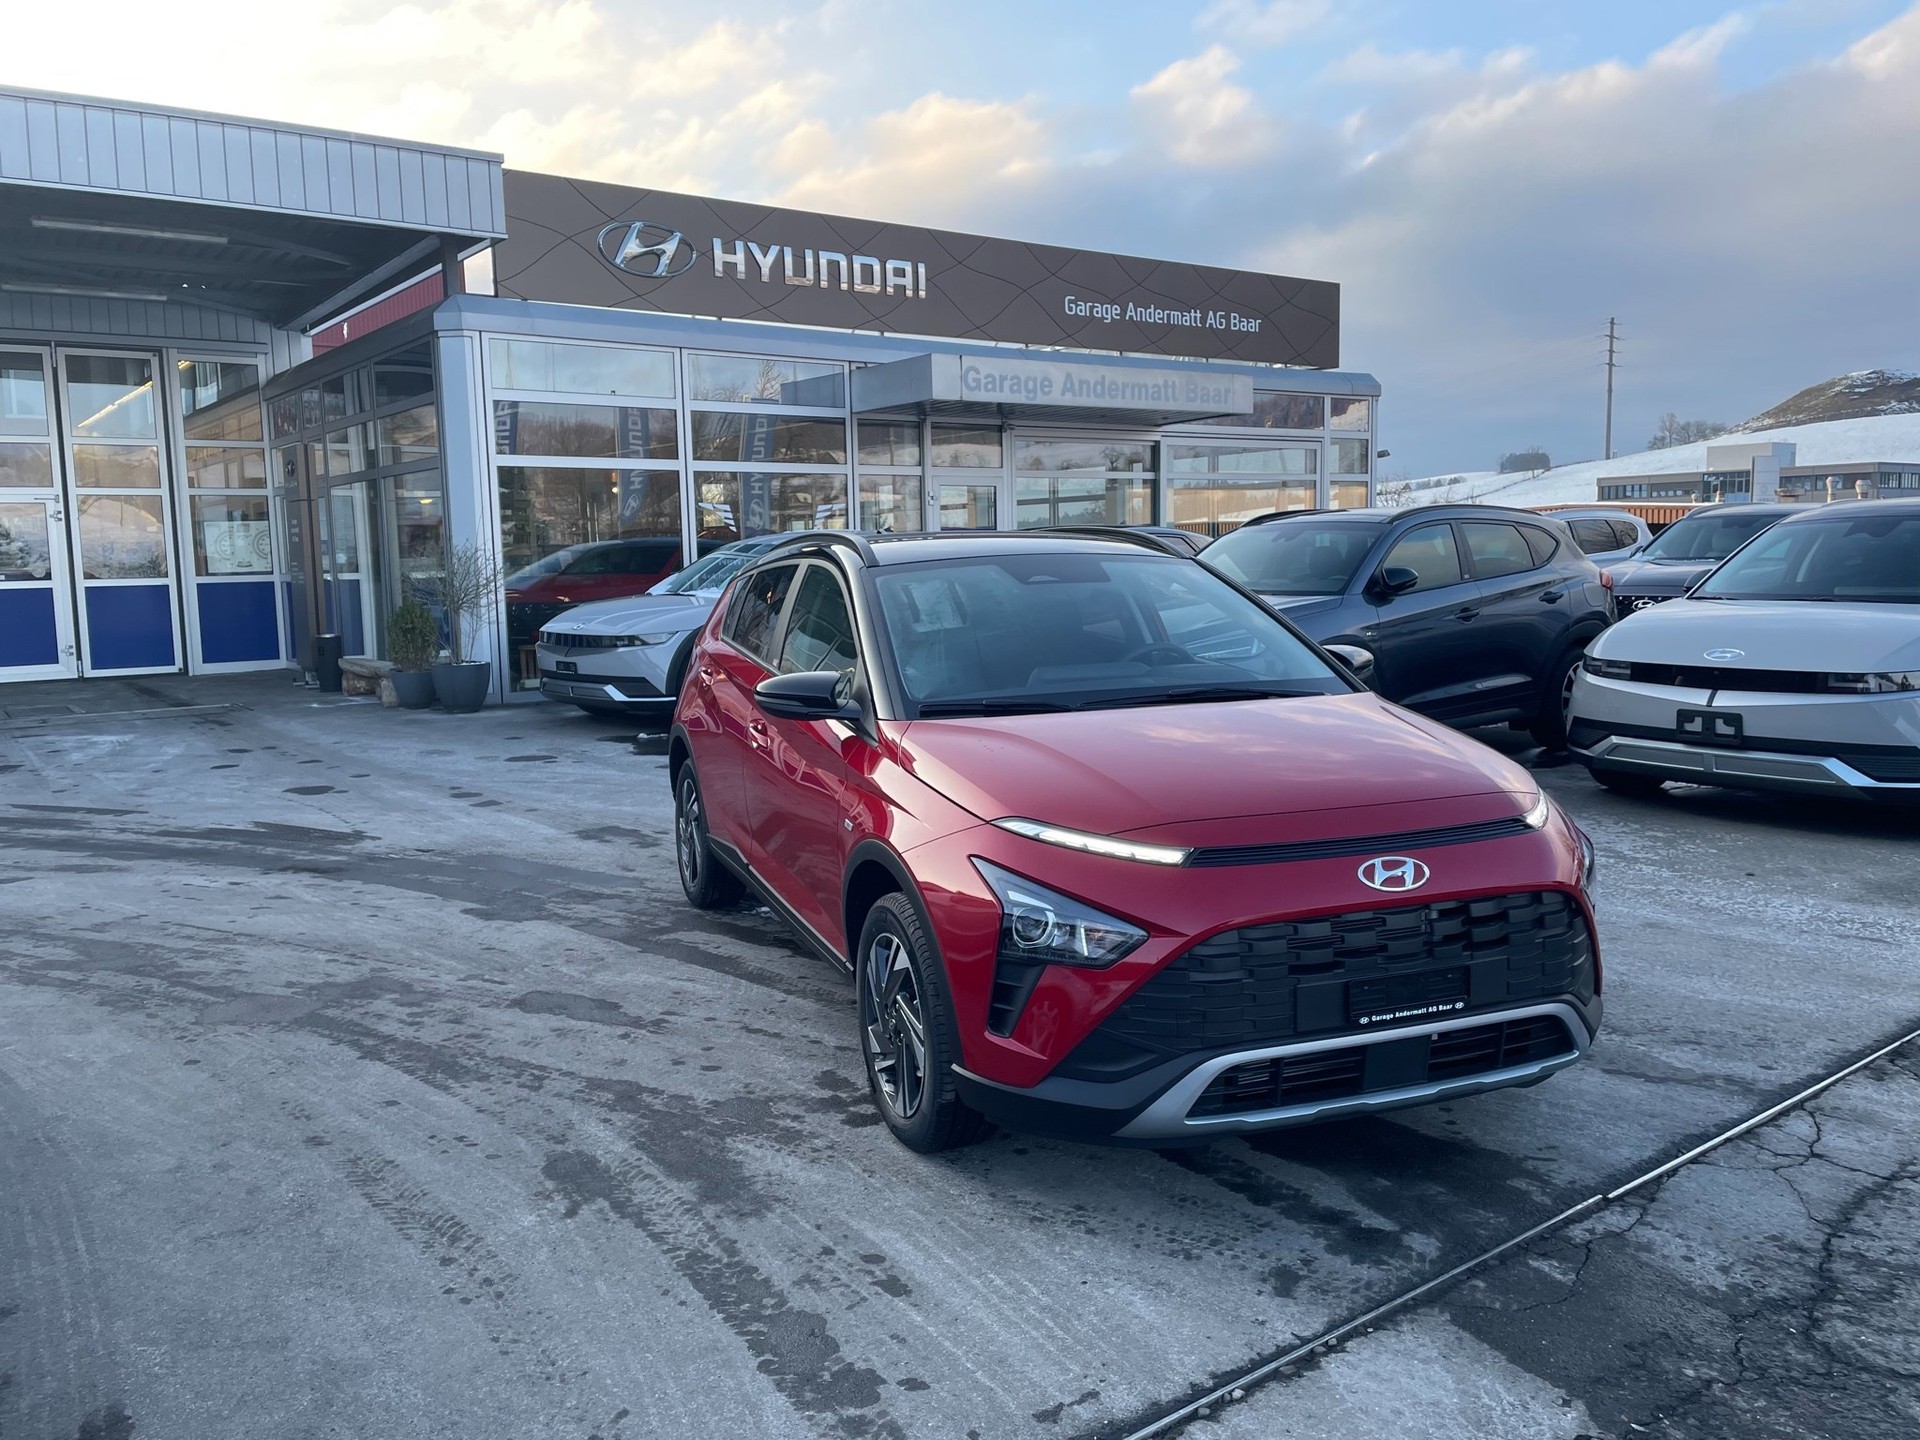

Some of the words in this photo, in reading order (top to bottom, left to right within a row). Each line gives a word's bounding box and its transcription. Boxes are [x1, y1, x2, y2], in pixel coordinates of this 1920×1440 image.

[712, 237, 926, 299] HYUNDAI
[1064, 295, 1121, 323] Garage
[1125, 302, 1202, 327] Andermatt
[1206, 310, 1226, 329] AG
[1230, 313, 1262, 333] Baar
[963, 365, 1054, 401] Garage
[1060, 372, 1178, 402] Andermatt
[1184, 379, 1232, 405] Baar
[750, 415, 768, 494] HYUND
[1371, 1013, 1394, 1022] Garage
[1395, 1007, 1427, 1018] Andermatt
[1428, 1005, 1437, 1013] AG
[1438, 1003, 1453, 1011] Baar
